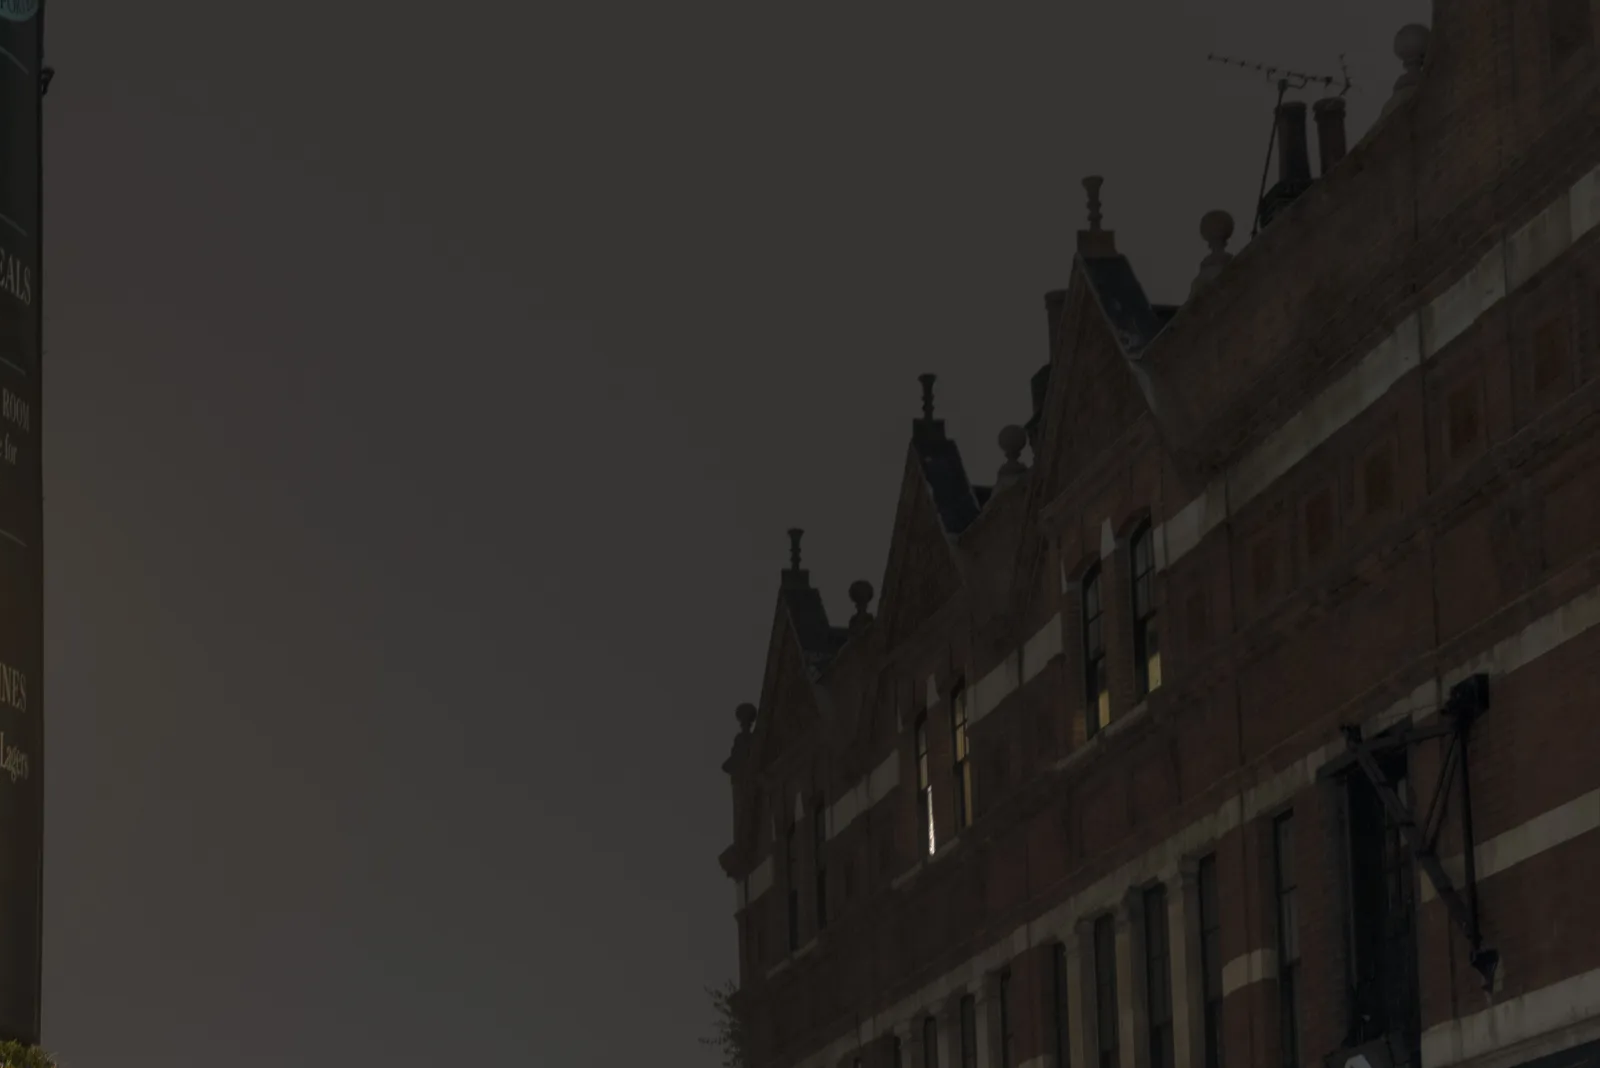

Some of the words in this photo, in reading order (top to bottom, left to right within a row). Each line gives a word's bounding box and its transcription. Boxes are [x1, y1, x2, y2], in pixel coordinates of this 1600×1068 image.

[2, 388, 30, 432] ROOM
[4, 432, 18, 465] for
[0, 731, 30, 782] Lagers
